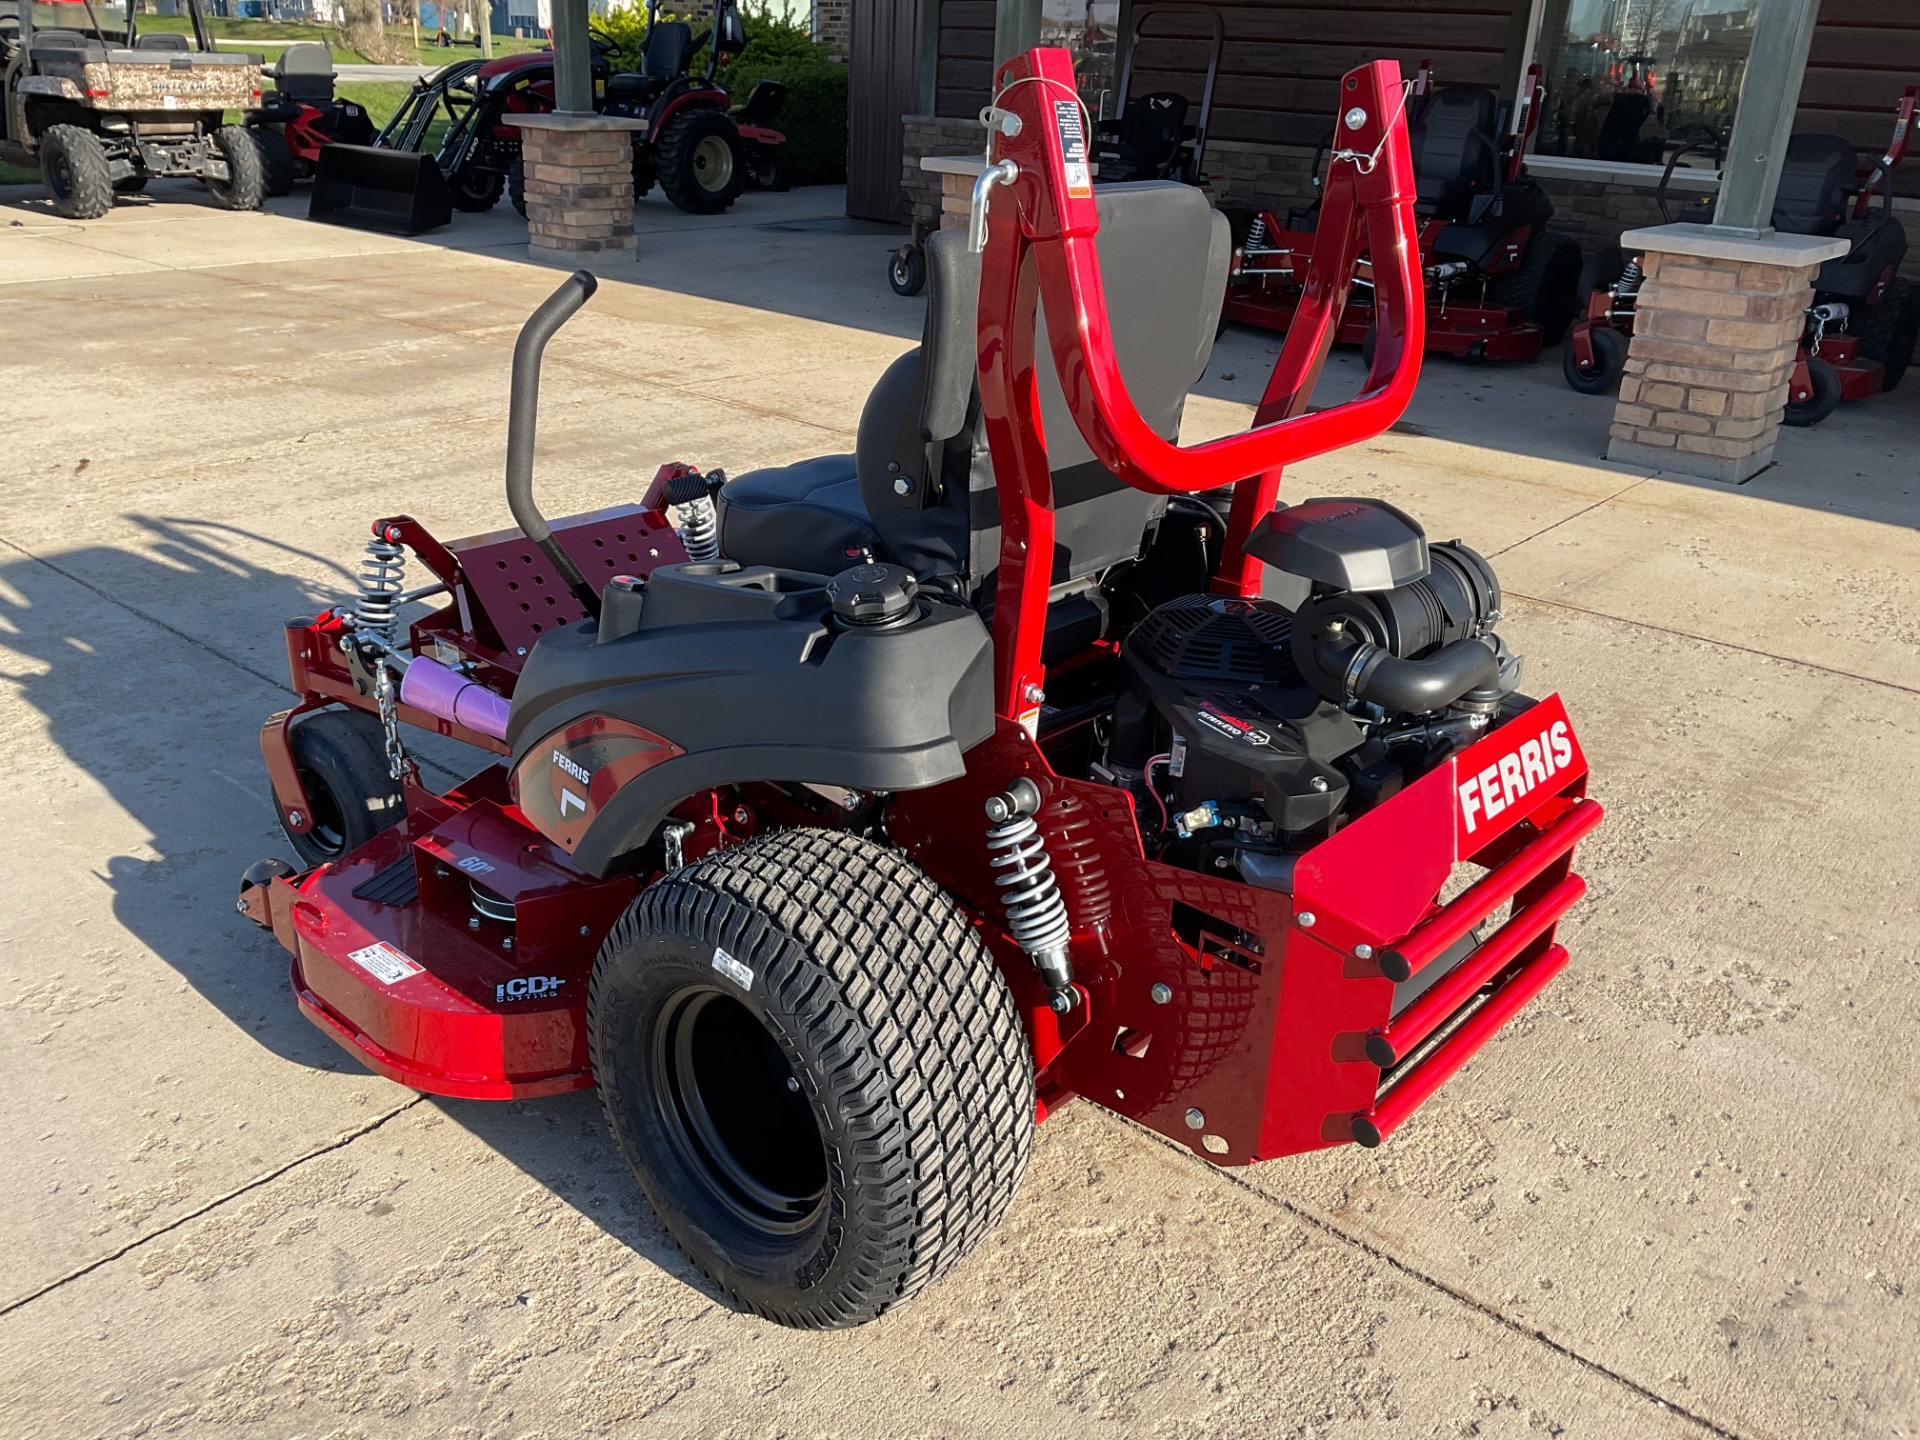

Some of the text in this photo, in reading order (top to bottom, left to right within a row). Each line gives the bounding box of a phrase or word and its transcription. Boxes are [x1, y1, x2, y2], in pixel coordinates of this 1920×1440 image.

[553, 749, 590, 785] FERRIS
[1458, 720, 1572, 834] FERRIS
[458, 856, 496, 873] 60"
[496, 991, 558, 1003] CUTTING
[795, 1138, 847, 1293] MASTER
